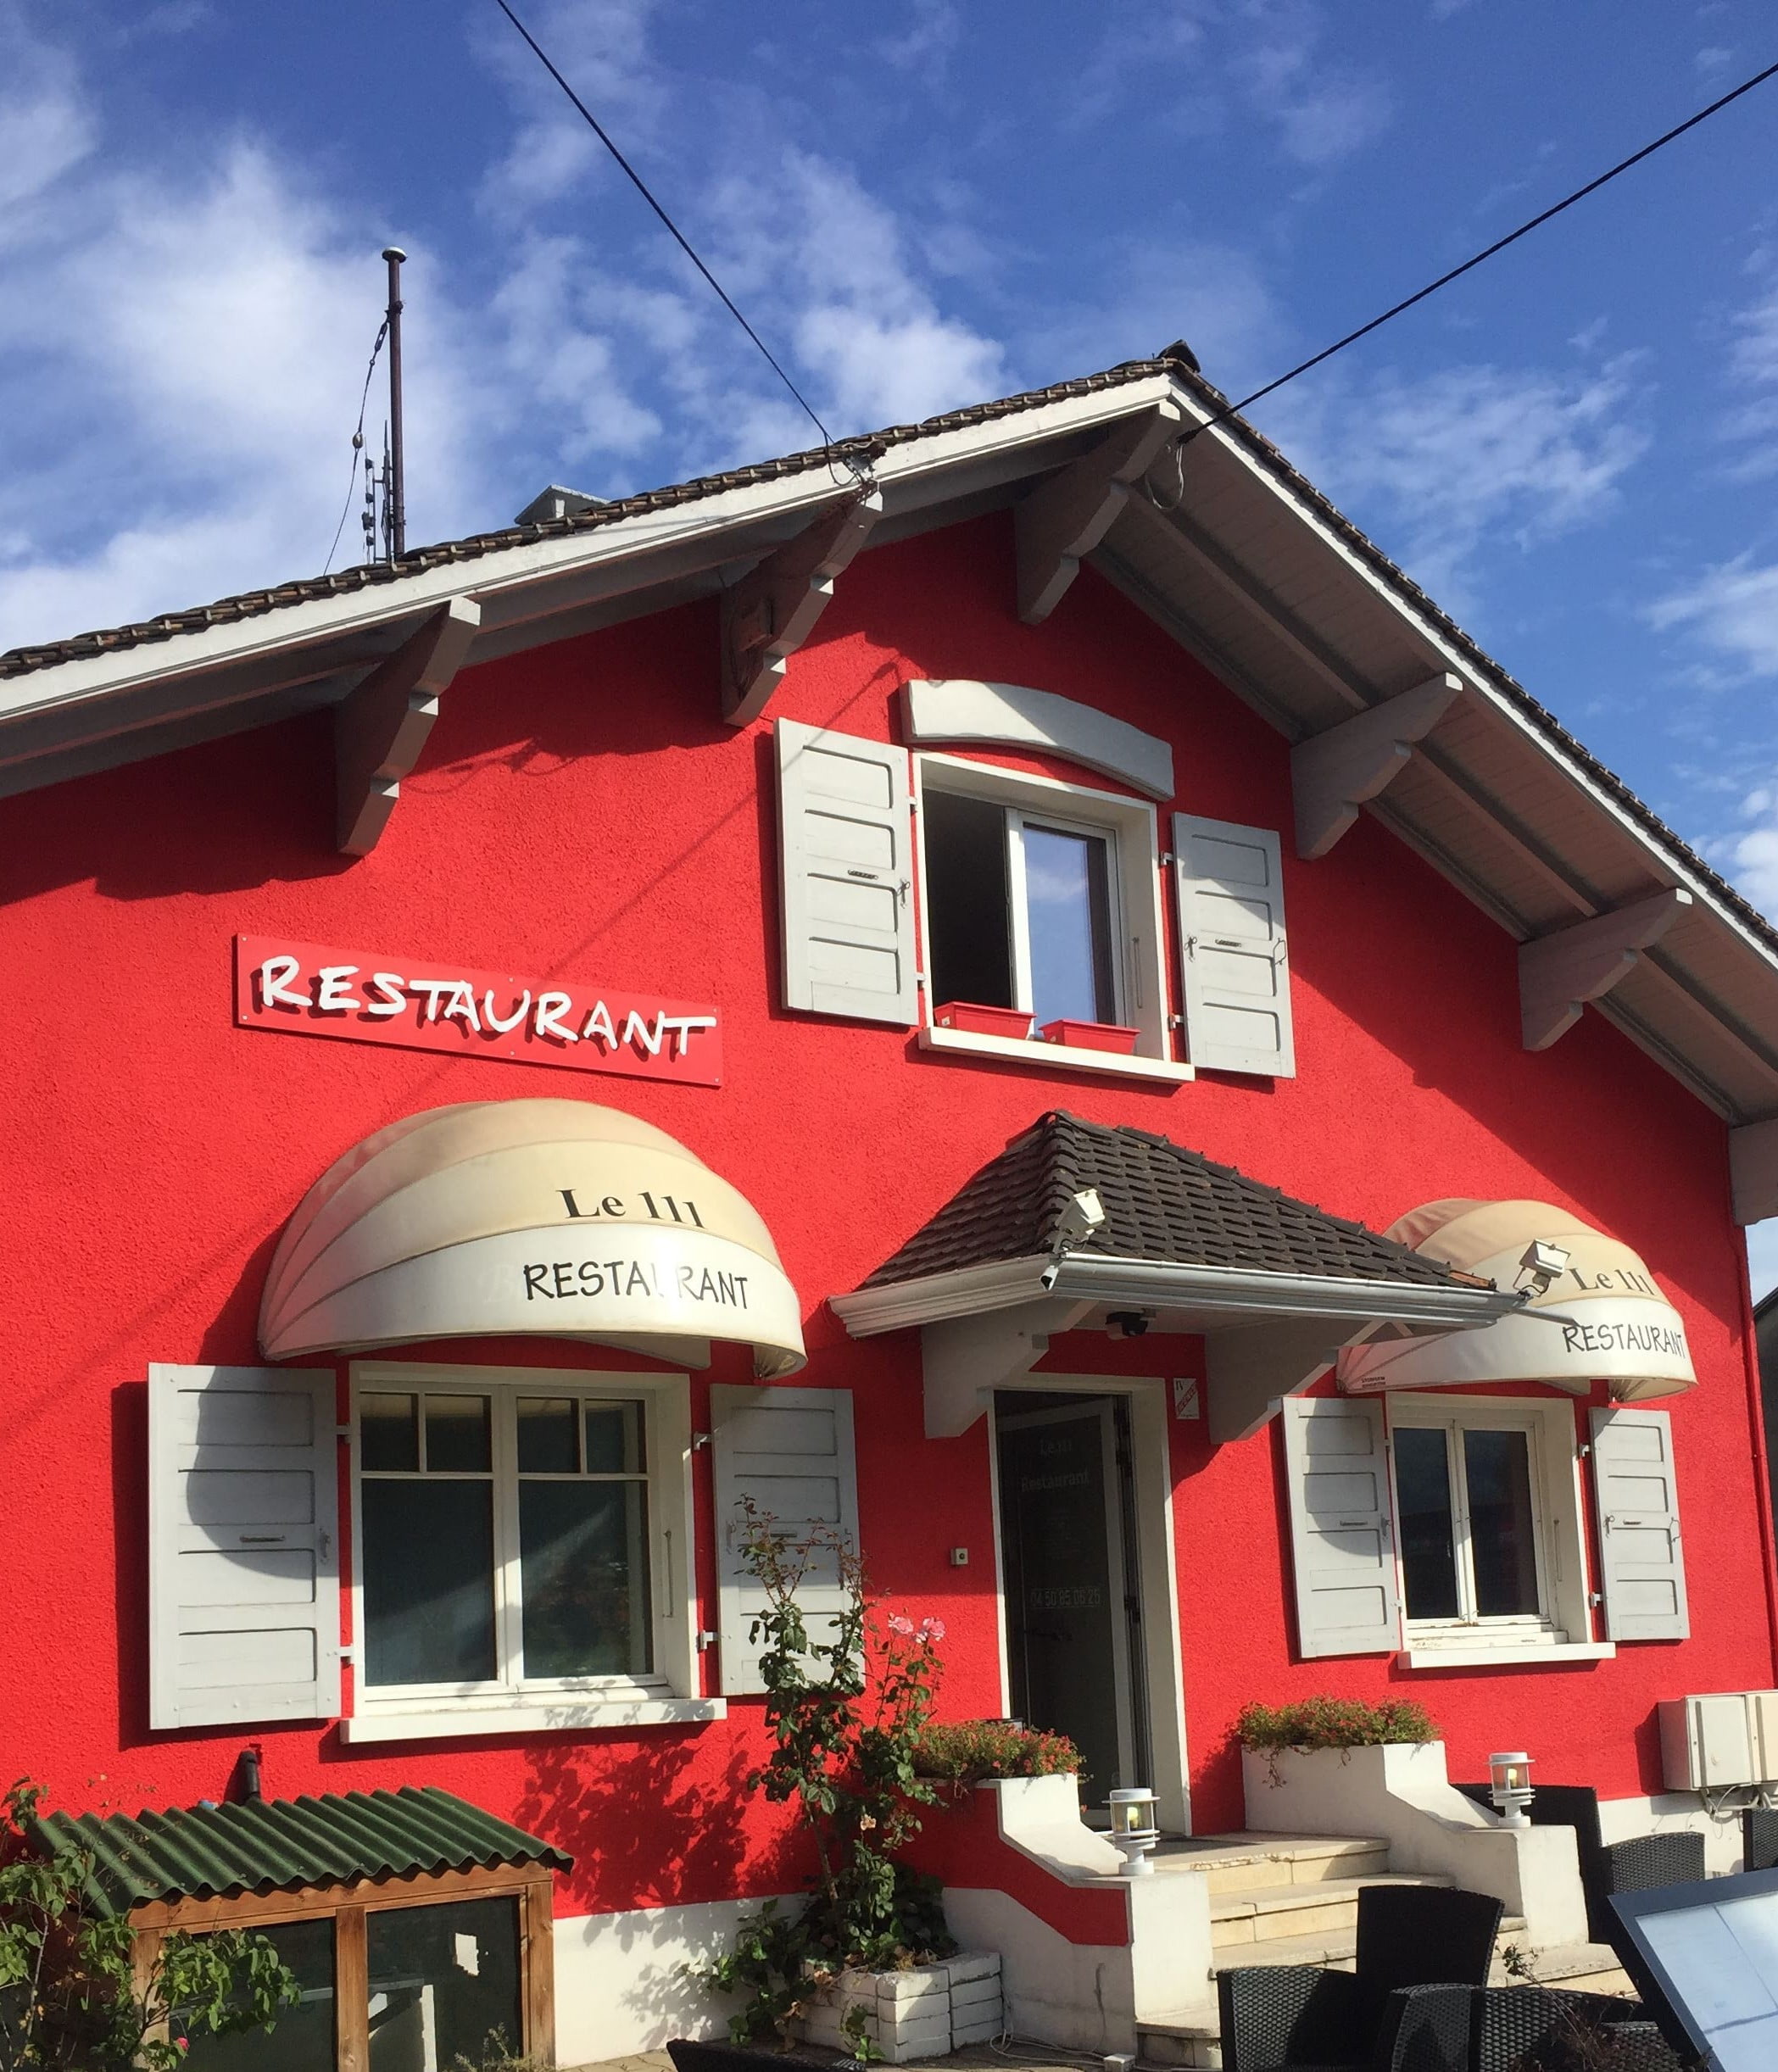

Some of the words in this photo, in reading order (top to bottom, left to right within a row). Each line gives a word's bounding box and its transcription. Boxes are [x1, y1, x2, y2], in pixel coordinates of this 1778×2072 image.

[261, 955, 716, 1055] RESTAURANT
[555, 1188, 627, 1219] Le
[1568, 1267, 1614, 1291] Le
[1563, 1323, 1686, 1359] RESTAURANT
[1022, 1468, 1090, 1492] Restaurant
